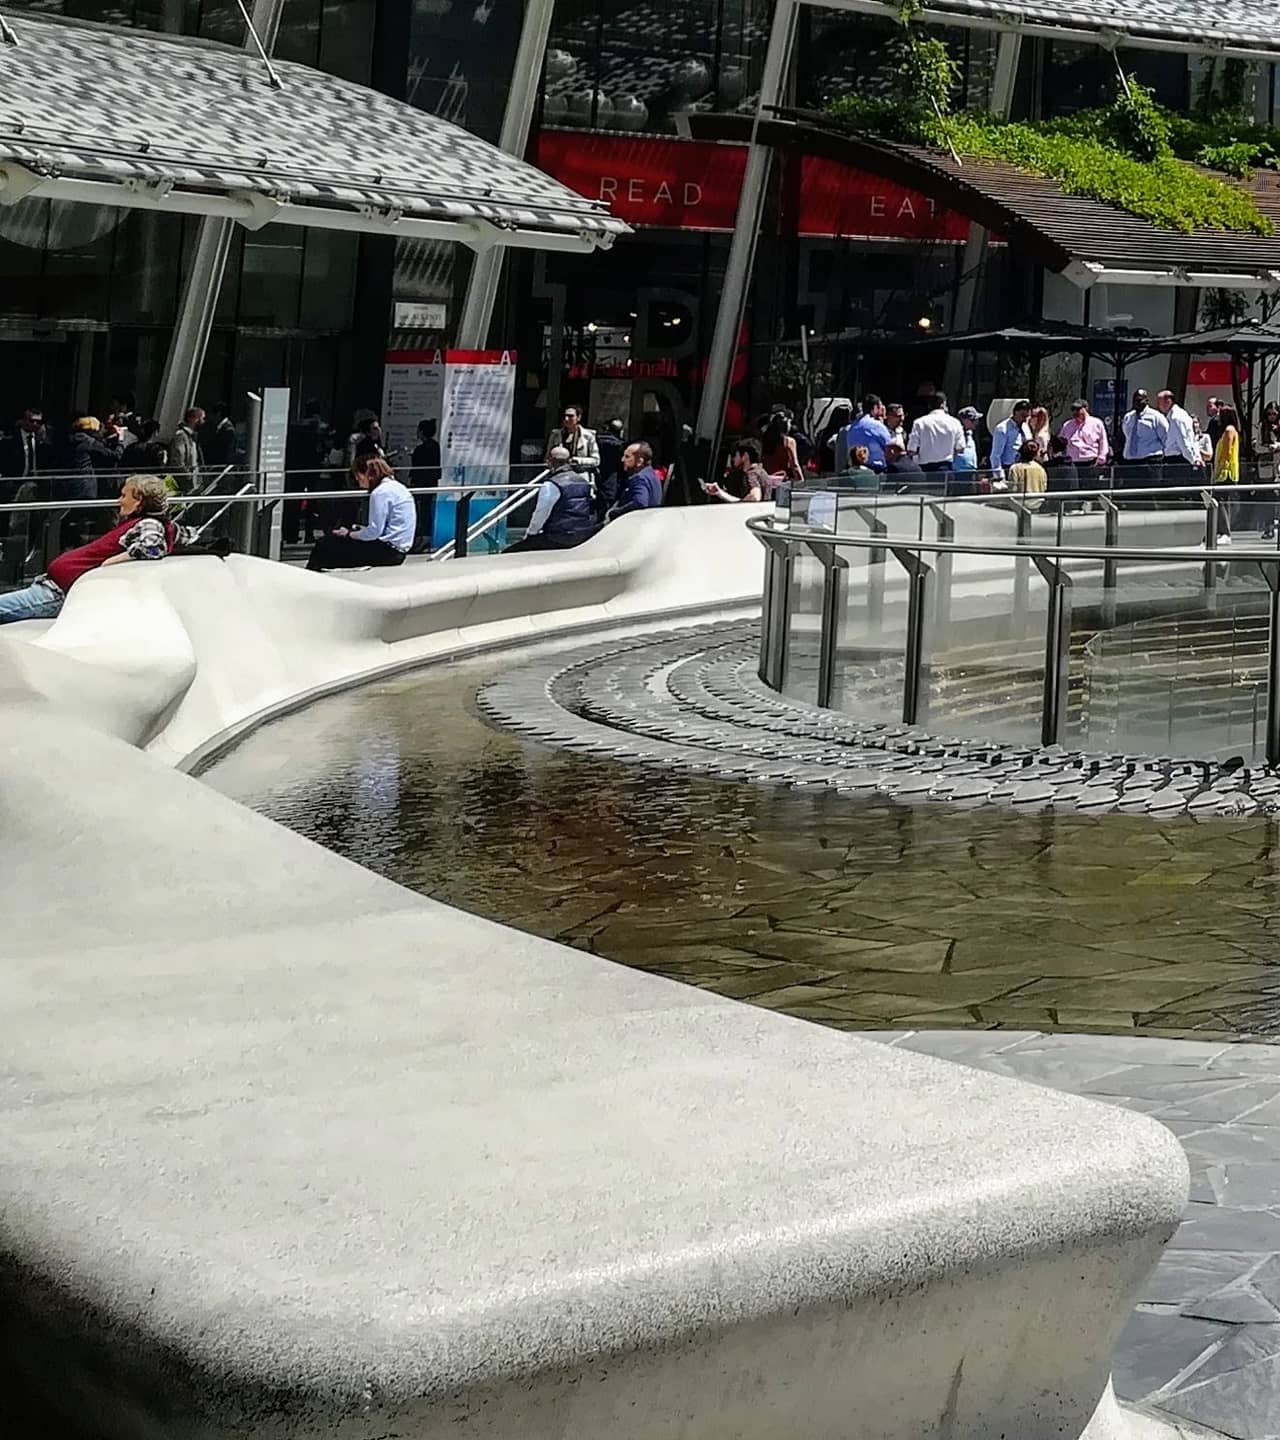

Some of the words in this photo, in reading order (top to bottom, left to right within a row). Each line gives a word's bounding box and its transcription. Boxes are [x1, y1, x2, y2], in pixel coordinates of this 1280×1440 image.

[599, 176, 703, 206] READ
[870, 195, 935, 220] EAT
[432, 348, 443, 365] A
[499, 350, 512, 366] A
